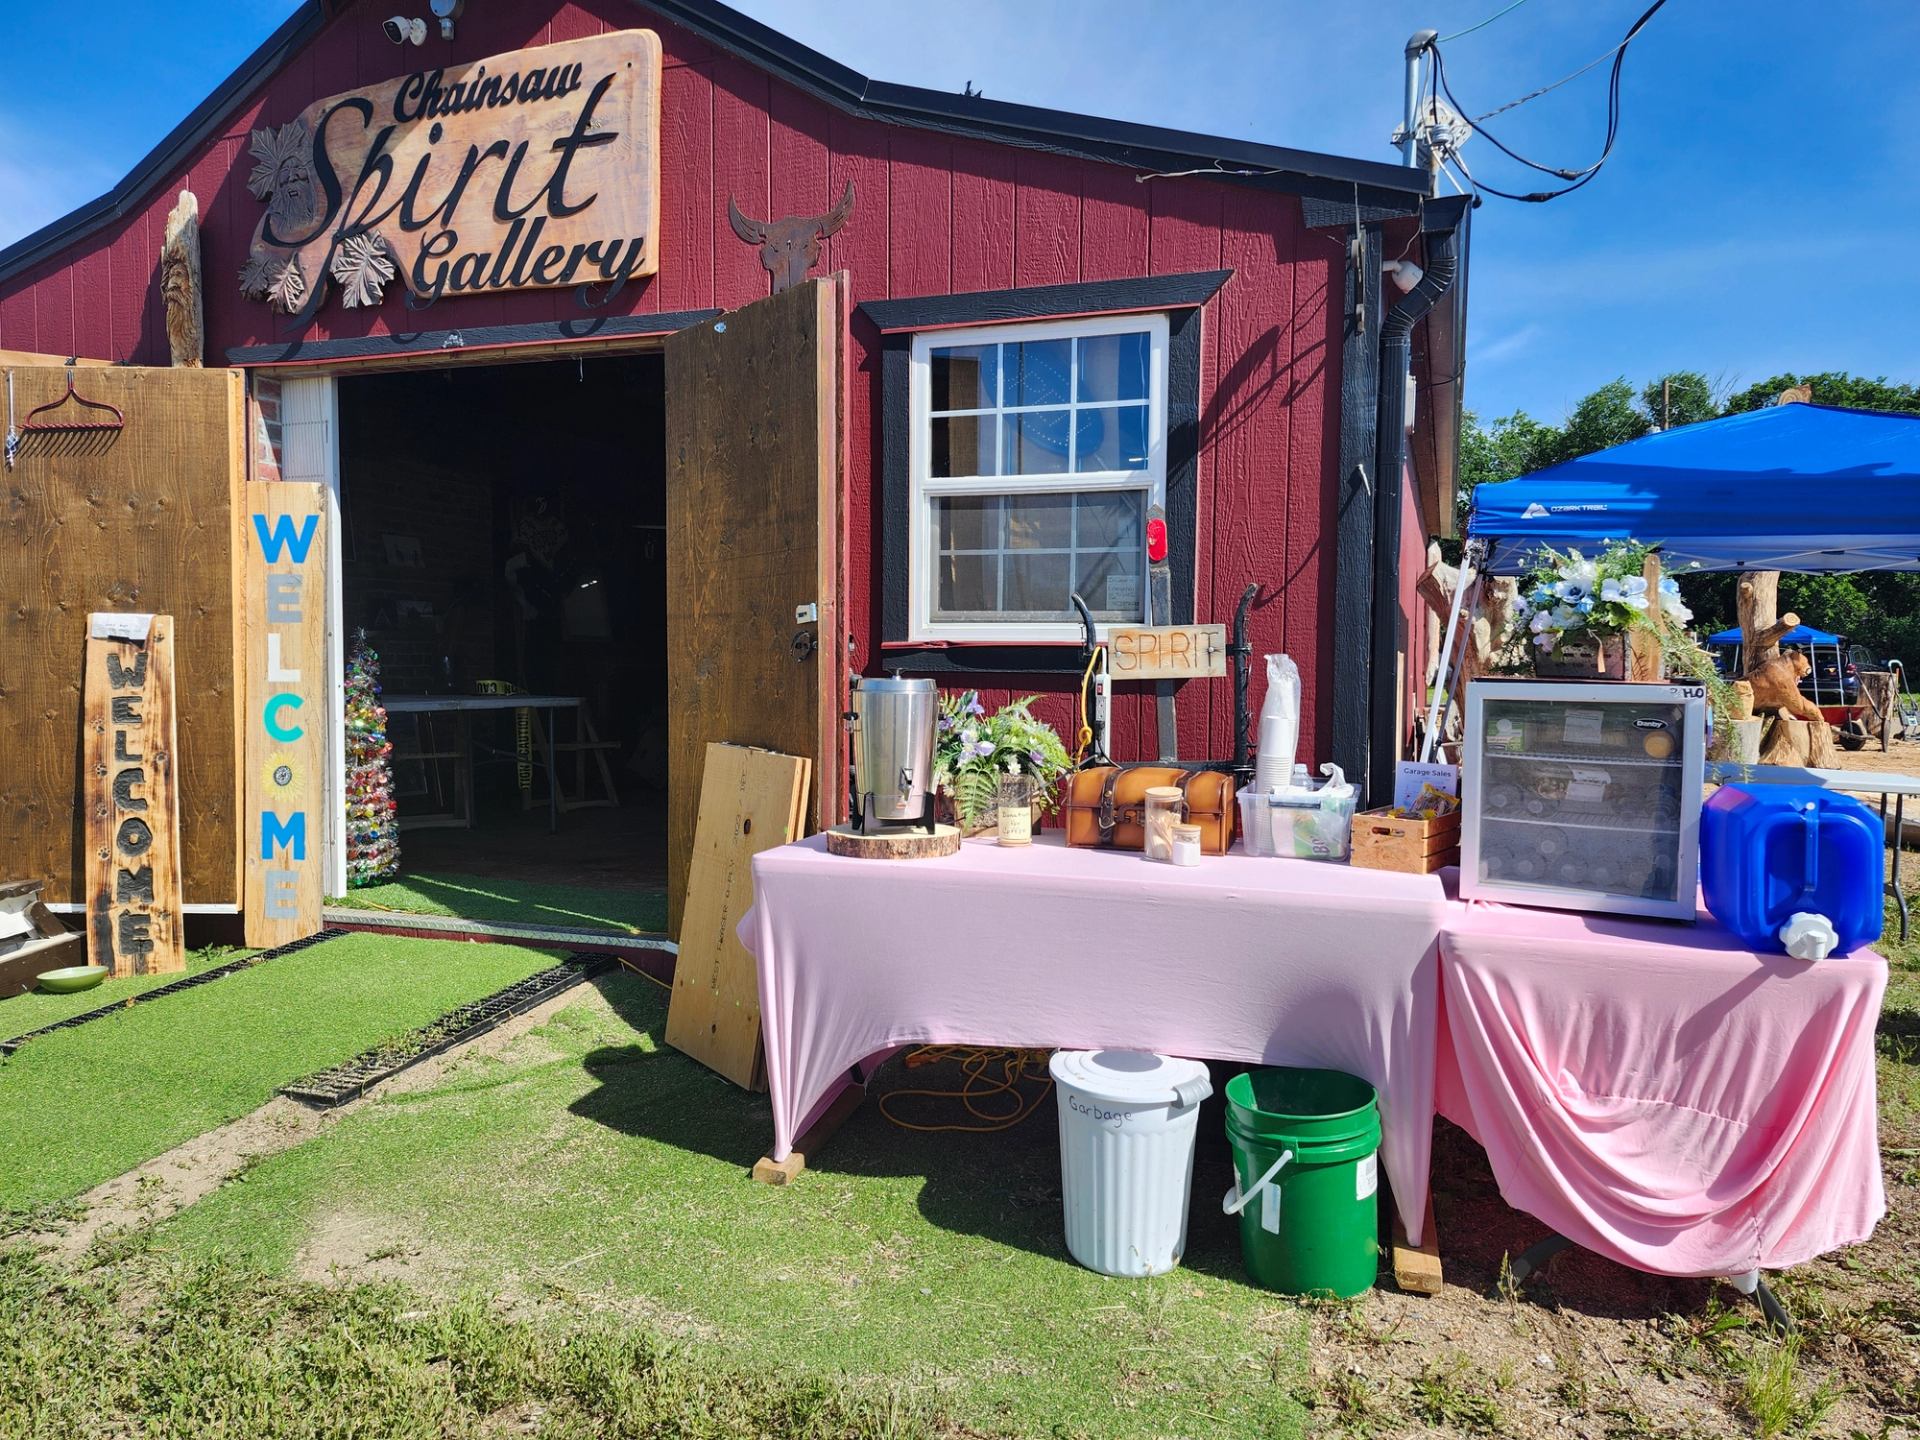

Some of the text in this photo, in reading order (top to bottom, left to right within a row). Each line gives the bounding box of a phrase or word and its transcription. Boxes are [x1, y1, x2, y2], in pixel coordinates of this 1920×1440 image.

[393, 61, 583, 124] Chainsaw
[260, 72, 619, 335] Spirit
[405, 215, 645, 311] Gallery
[1550, 503, 1608, 513] OZARK TRAIL
[1114, 632, 1220, 671] SPIRIT
[1636, 720, 1663, 729] Danby
[1403, 767, 1430, 776] Garage
[106, 651, 155, 956] WELCOME
[1068, 1095, 1134, 1129] Garbage
